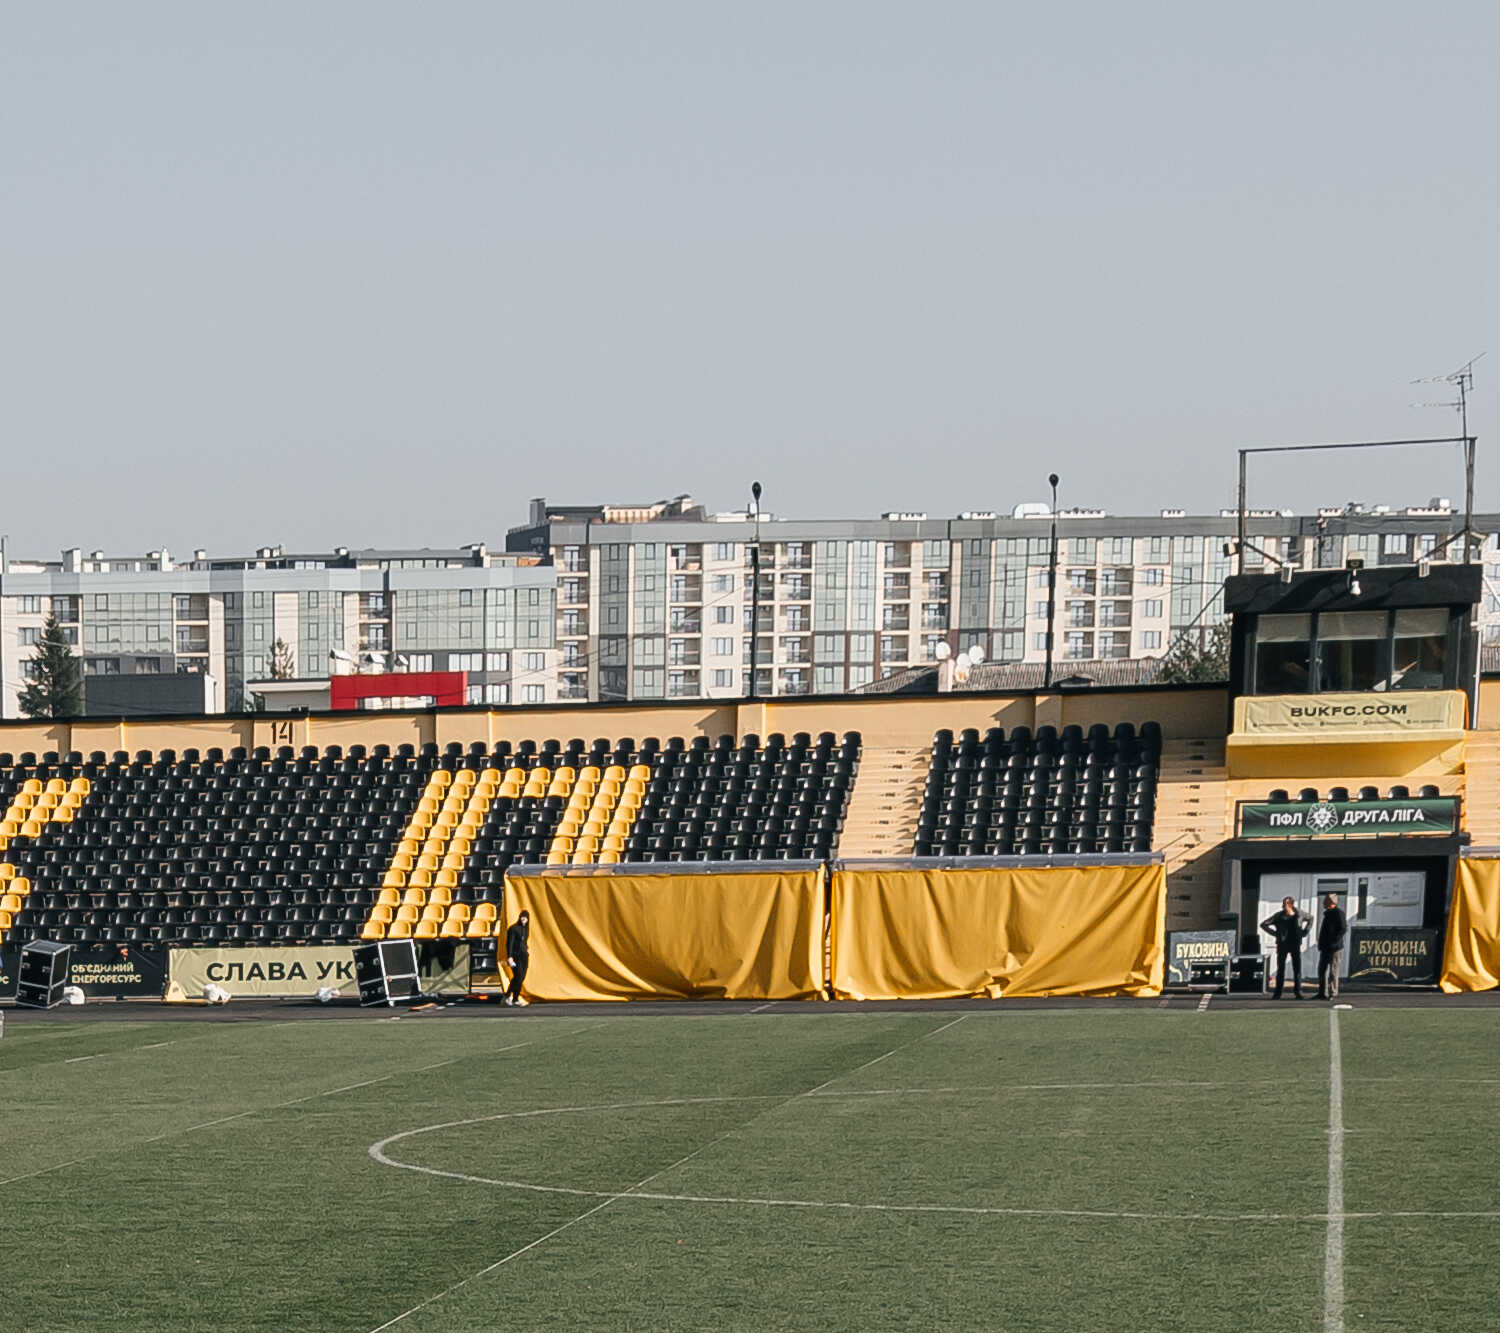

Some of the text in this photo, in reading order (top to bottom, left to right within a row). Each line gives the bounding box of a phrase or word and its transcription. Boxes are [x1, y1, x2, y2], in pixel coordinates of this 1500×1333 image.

[1290, 704, 1408, 718] BUKFC.COM
[271, 721, 293, 744] 14
[1269, 808, 1425, 827] ПФЛ ДРУГА ЛІГА
[1359, 940, 1428, 956] БУКОВИНА
[71, 973, 142, 984] ЕНЕРГОРЕСУРС
[206, 960, 355, 982] СЛАВА УК
